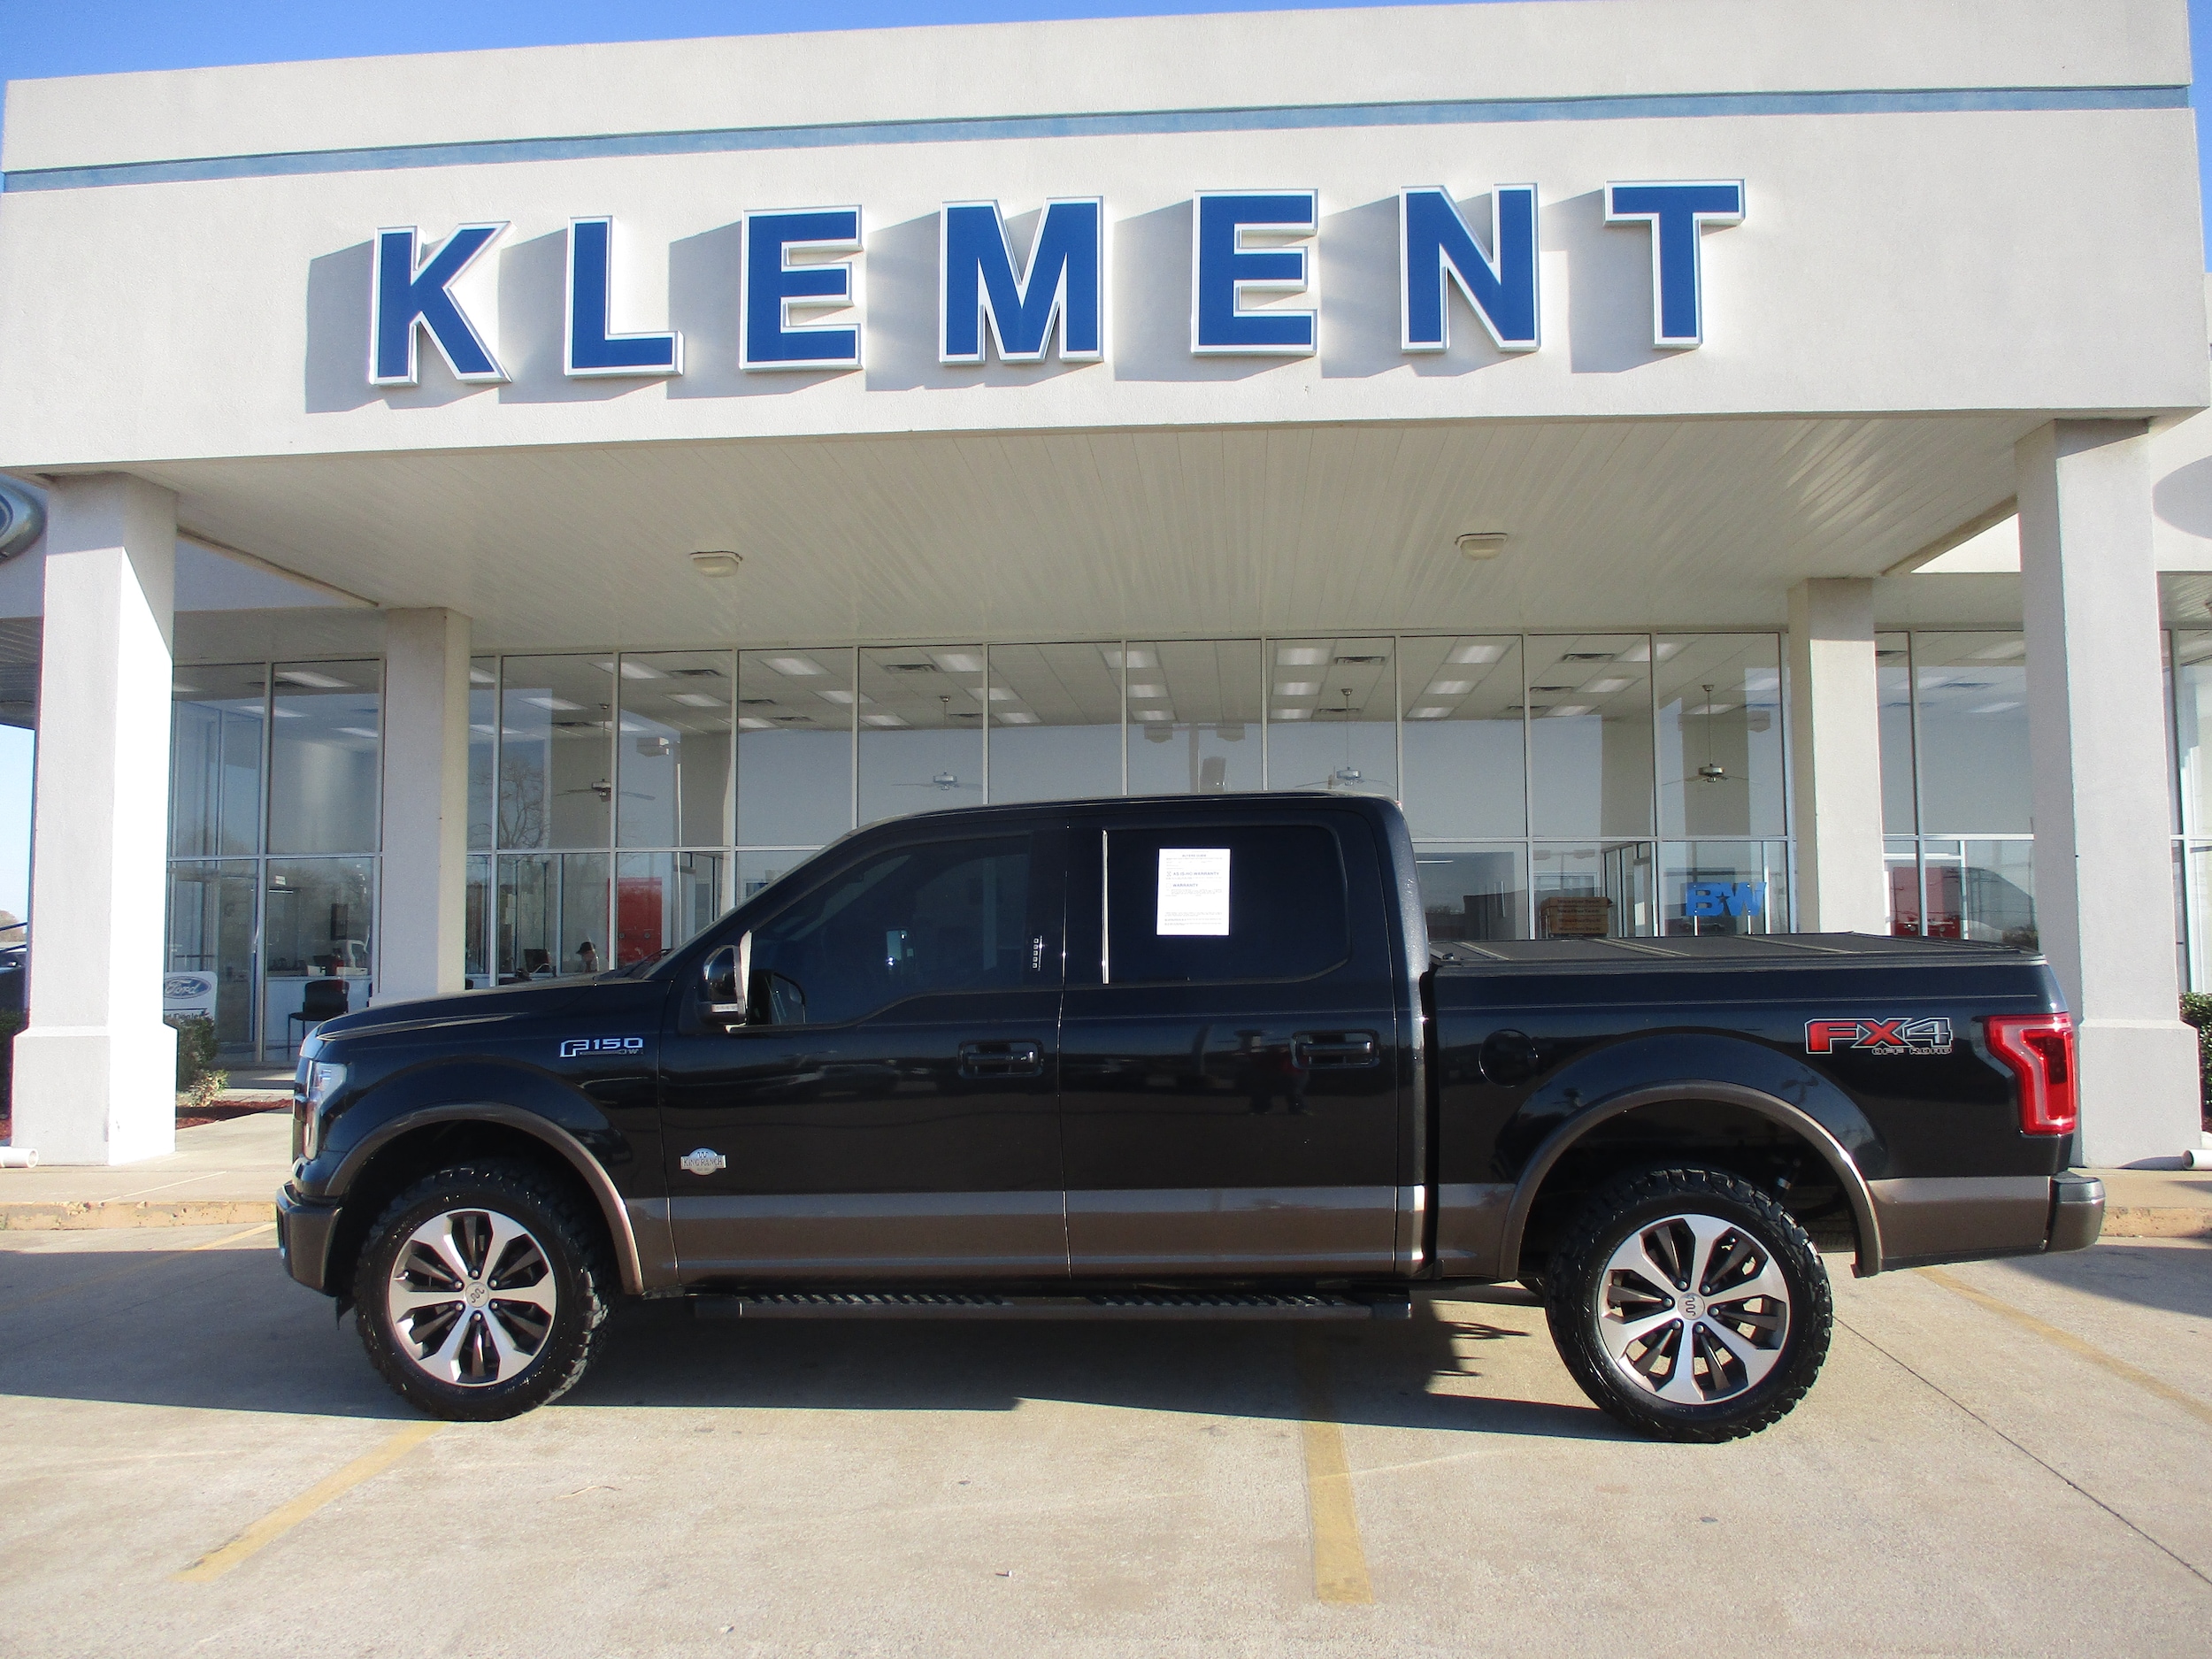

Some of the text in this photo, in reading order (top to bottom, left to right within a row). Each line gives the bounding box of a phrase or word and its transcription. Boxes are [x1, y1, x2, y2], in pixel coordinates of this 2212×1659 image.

[368, 179, 1746, 387] KLEMENT
[165, 979, 200, 995] Ford
[1804, 1017, 1954, 1055] FX4
[1871, 1047, 1953, 1056] OFF ROAD
[683, 1156, 723, 1167] KING RANCH
